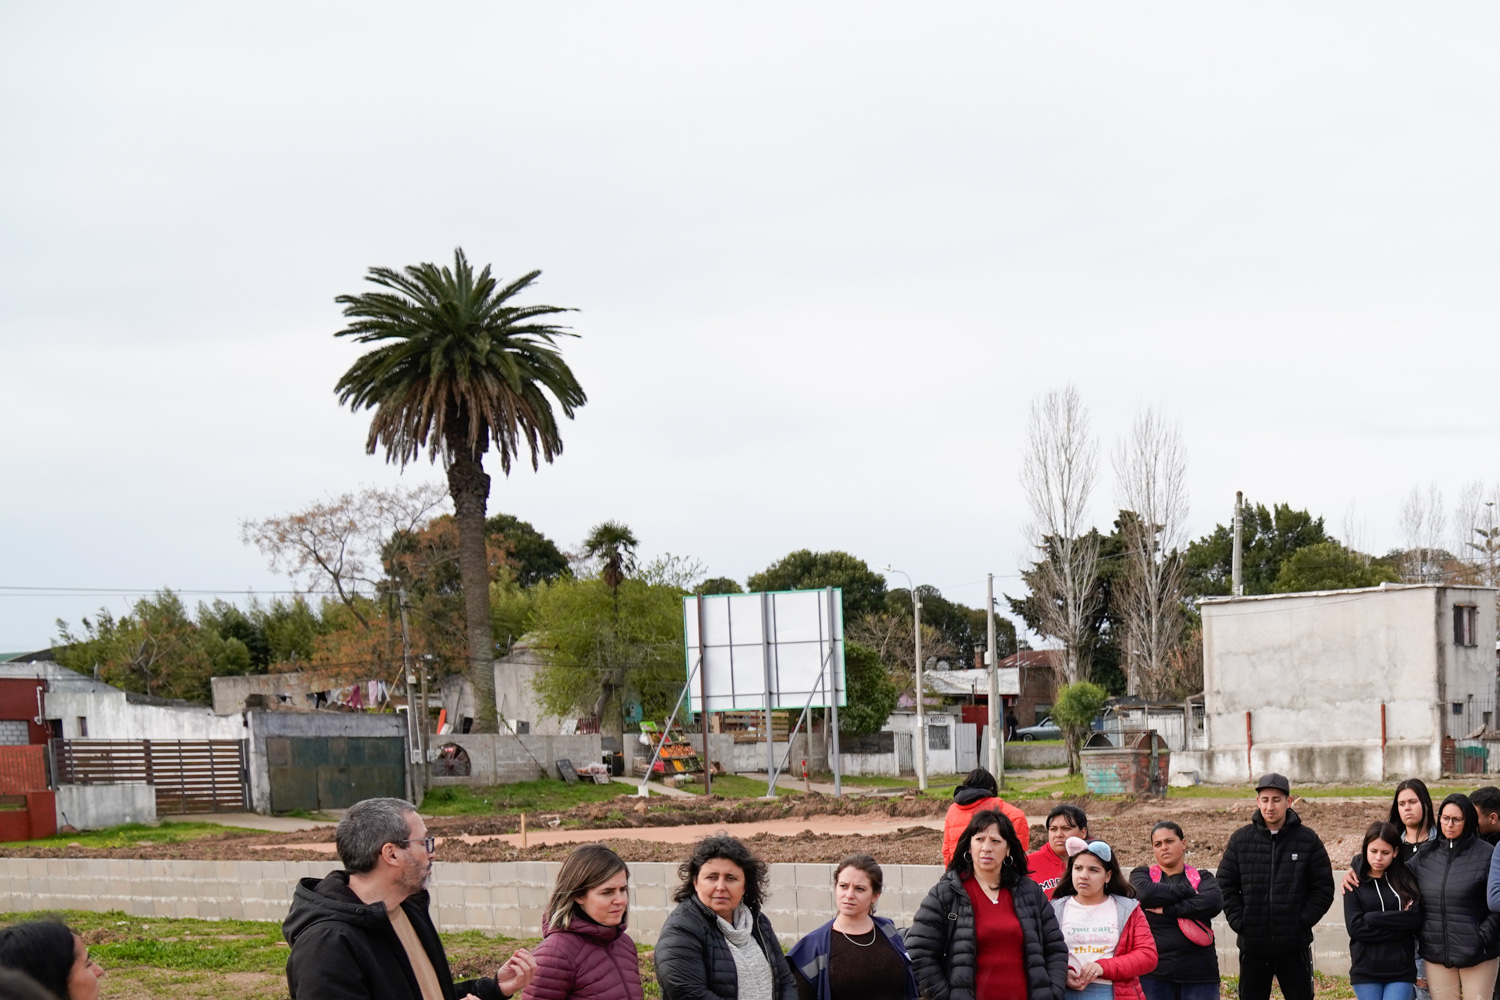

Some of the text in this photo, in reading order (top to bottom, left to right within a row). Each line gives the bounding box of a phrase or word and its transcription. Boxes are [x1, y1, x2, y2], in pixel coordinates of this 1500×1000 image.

[1067, 926, 1114, 935] you can
[1073, 933, 1110, 944] do the
[1074, 945, 1109, 954] thing
